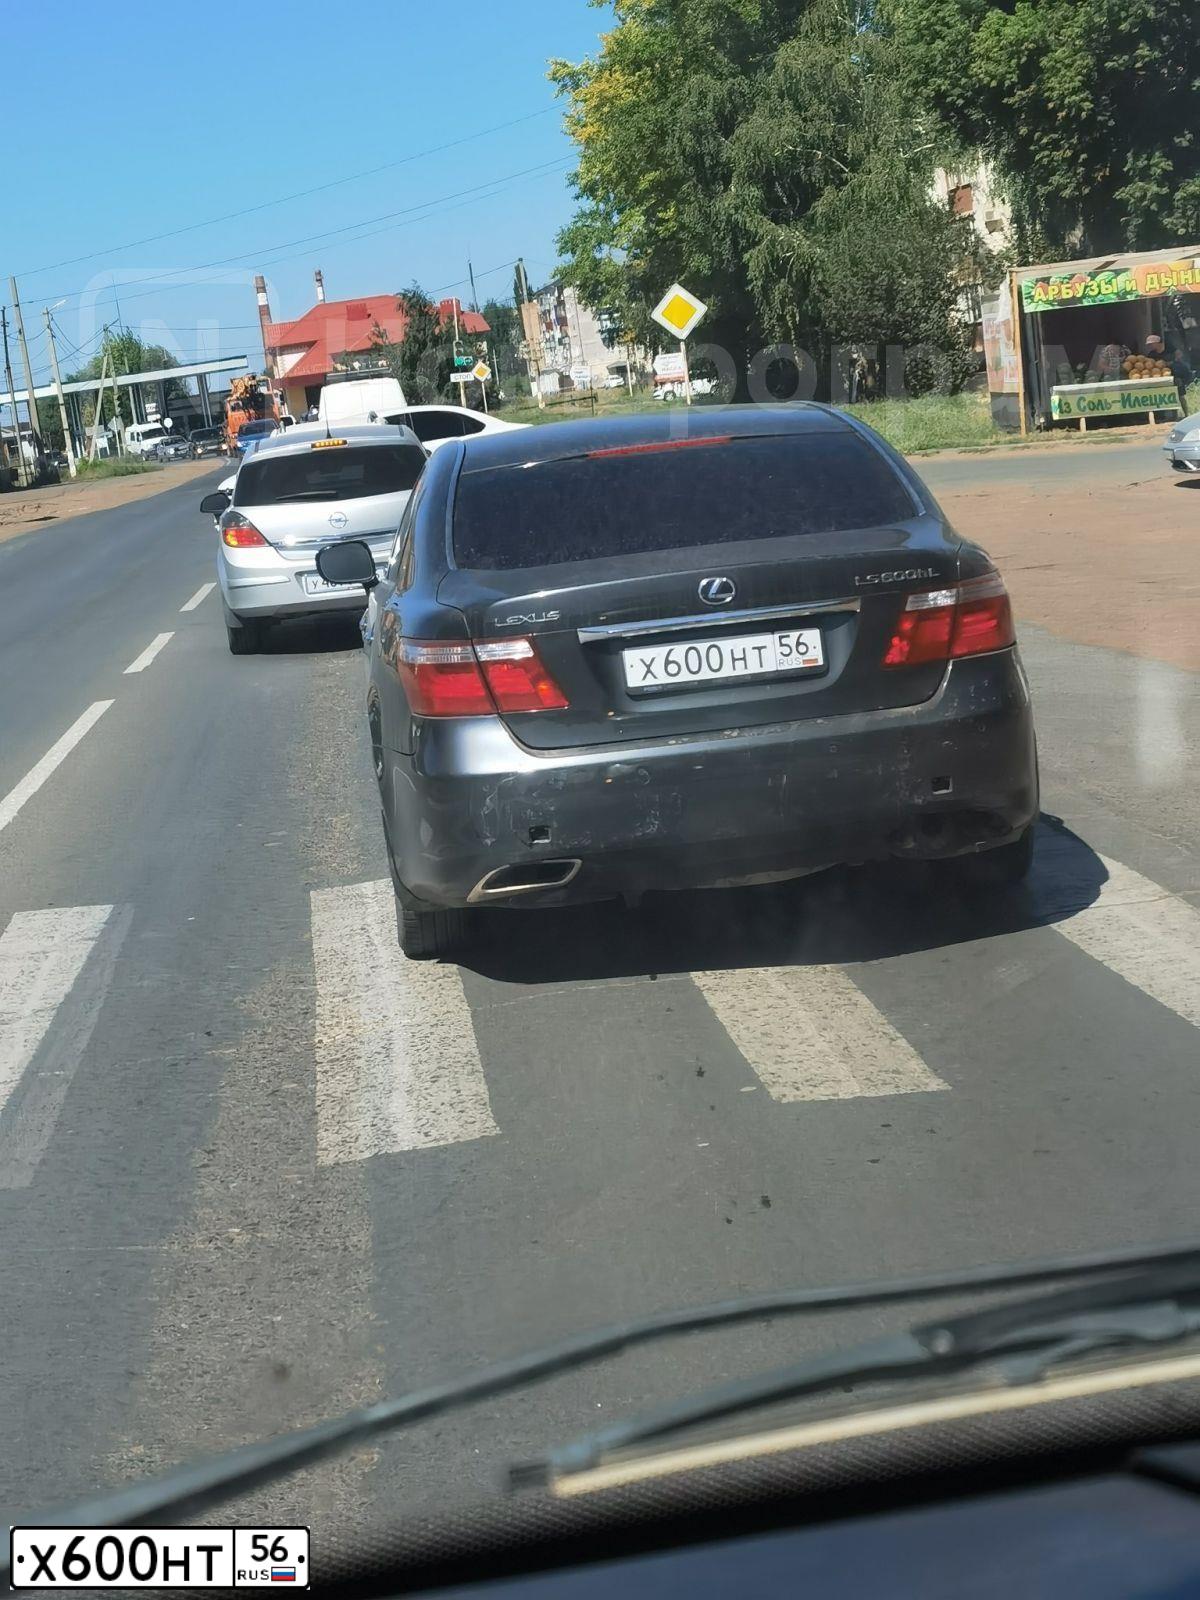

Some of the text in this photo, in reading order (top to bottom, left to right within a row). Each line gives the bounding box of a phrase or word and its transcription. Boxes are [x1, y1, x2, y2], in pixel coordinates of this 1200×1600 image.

[1033, 278, 1118, 302] АРБУЗЫ
[1145, 268, 1200, 291] ДЫН
[1076, 391, 1178, 413] Соль-Илецка
[494, 610, 561, 627] LEXUS
[640, 633, 810, 681] Х600НТ 56
[778, 656, 803, 667] RUS
